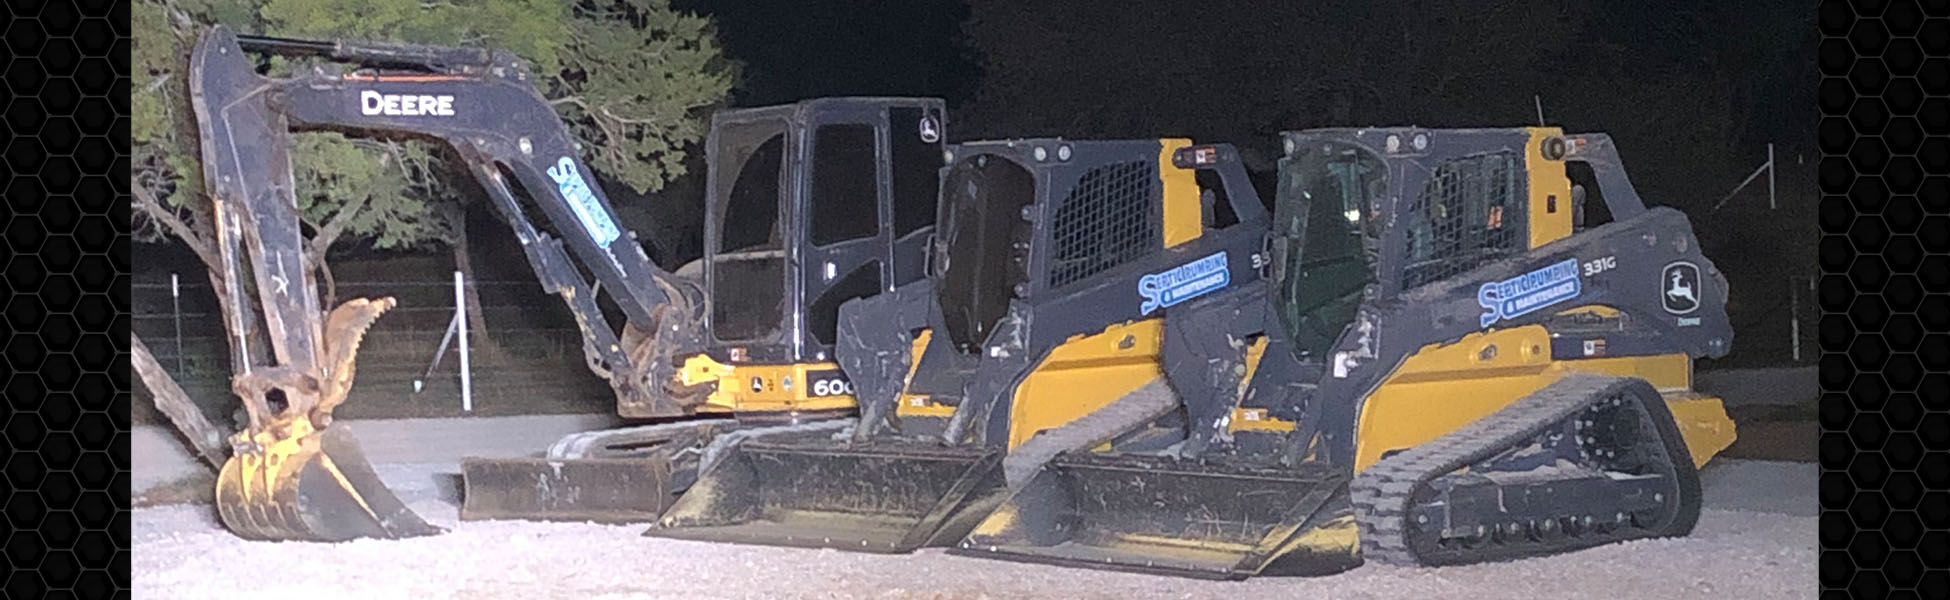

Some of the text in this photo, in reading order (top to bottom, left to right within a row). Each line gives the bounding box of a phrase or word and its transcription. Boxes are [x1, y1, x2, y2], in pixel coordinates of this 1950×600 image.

[361, 90, 455, 116] DEERE
[1583, 256, 1616, 277] 331G
[1478, 258, 1579, 328] SEPTIC PUMPING
